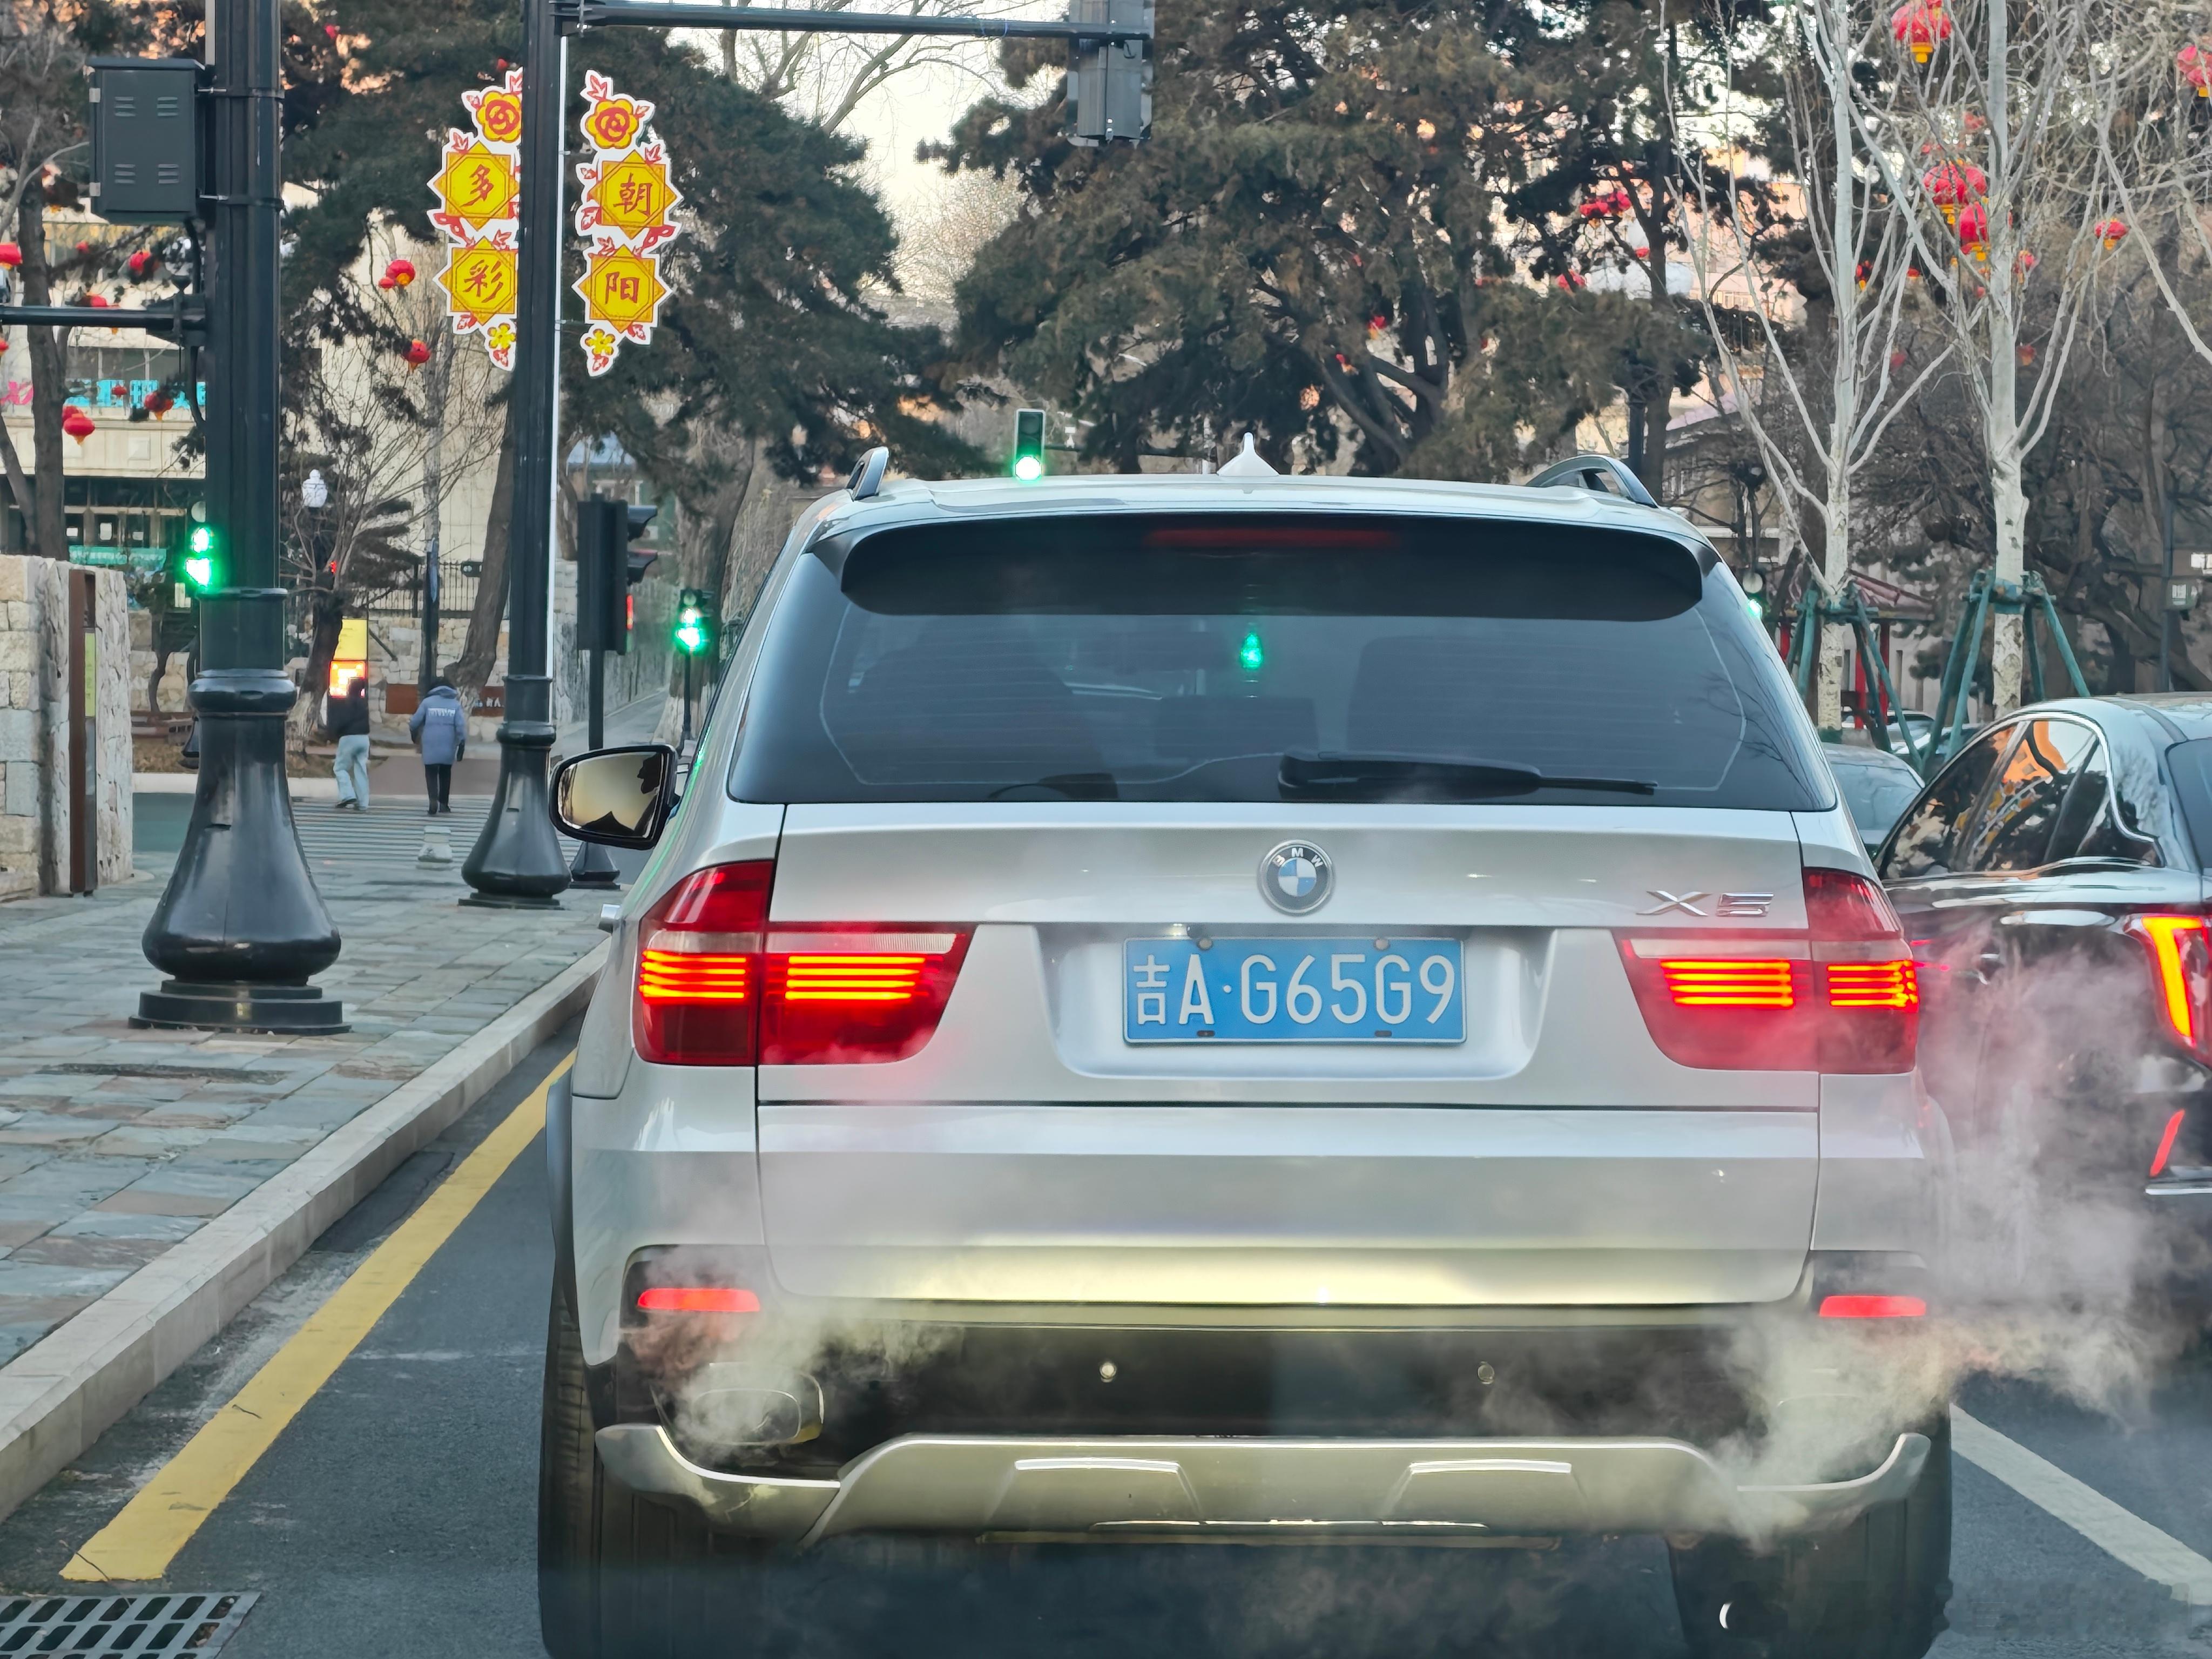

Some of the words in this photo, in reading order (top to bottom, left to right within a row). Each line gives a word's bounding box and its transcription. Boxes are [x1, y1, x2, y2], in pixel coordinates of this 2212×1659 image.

[461, 164, 503, 303] 多彩
[605, 173, 652, 305] 朝阳
[1272, 847, 1323, 867] BMW
[1635, 890, 1775, 917] X5
[1134, 954, 1455, 1025] 吉A·G65G9
